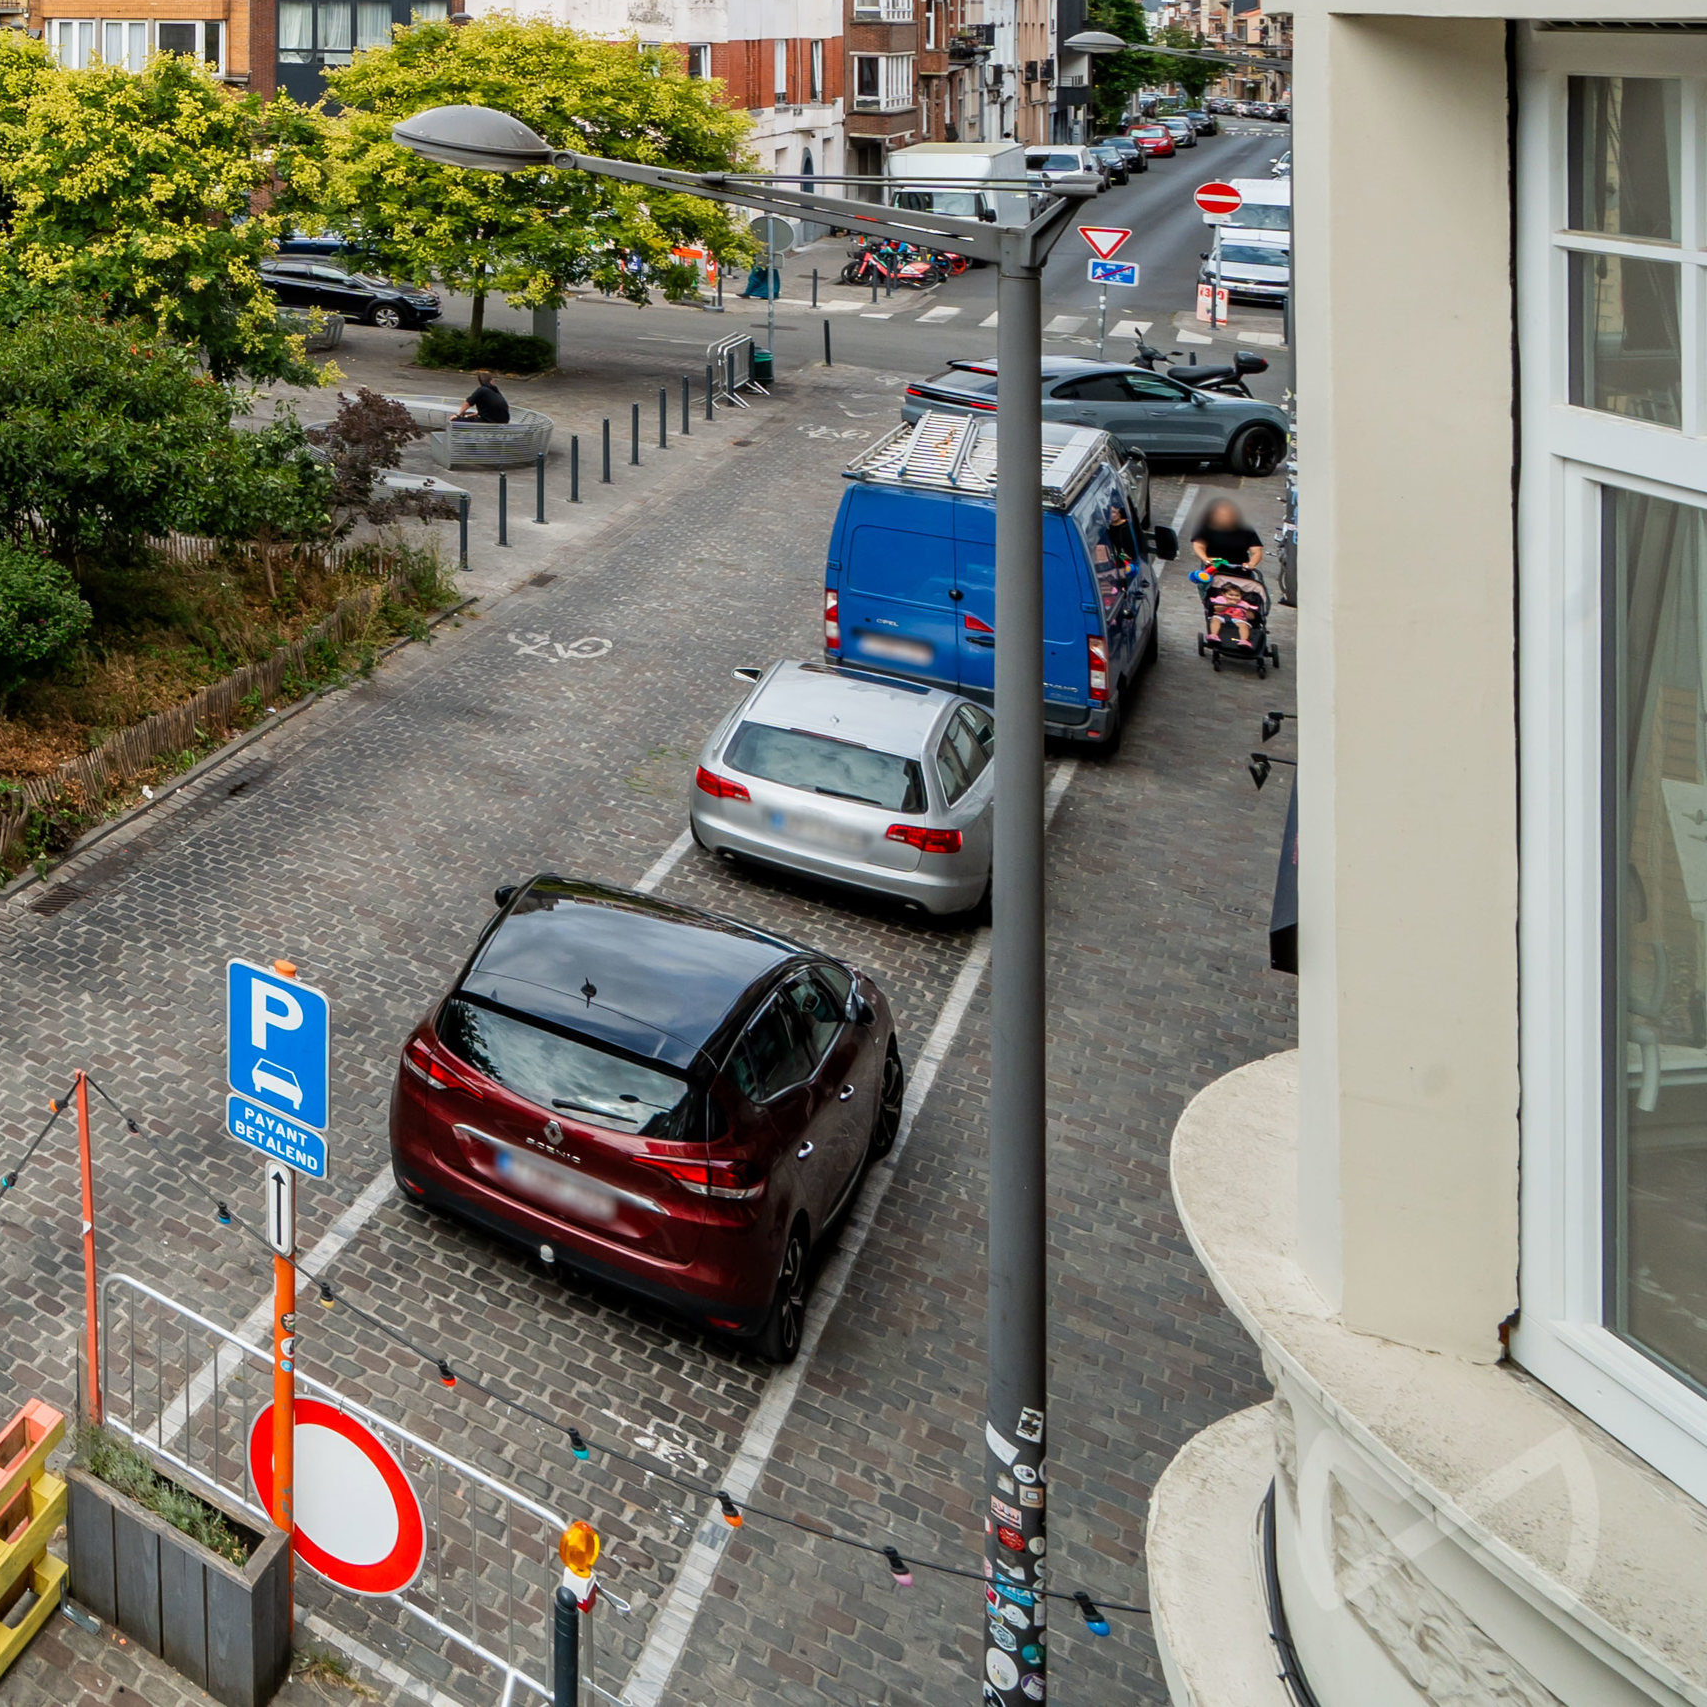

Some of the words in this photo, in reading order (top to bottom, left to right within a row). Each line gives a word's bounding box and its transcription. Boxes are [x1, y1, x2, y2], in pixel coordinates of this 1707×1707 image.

[251, 977, 304, 1051] P
[235, 1120, 318, 1171] BETALEND
[244, 1106, 308, 1147] PAYANT
[525, 1137, 581, 1164] SCENIC
